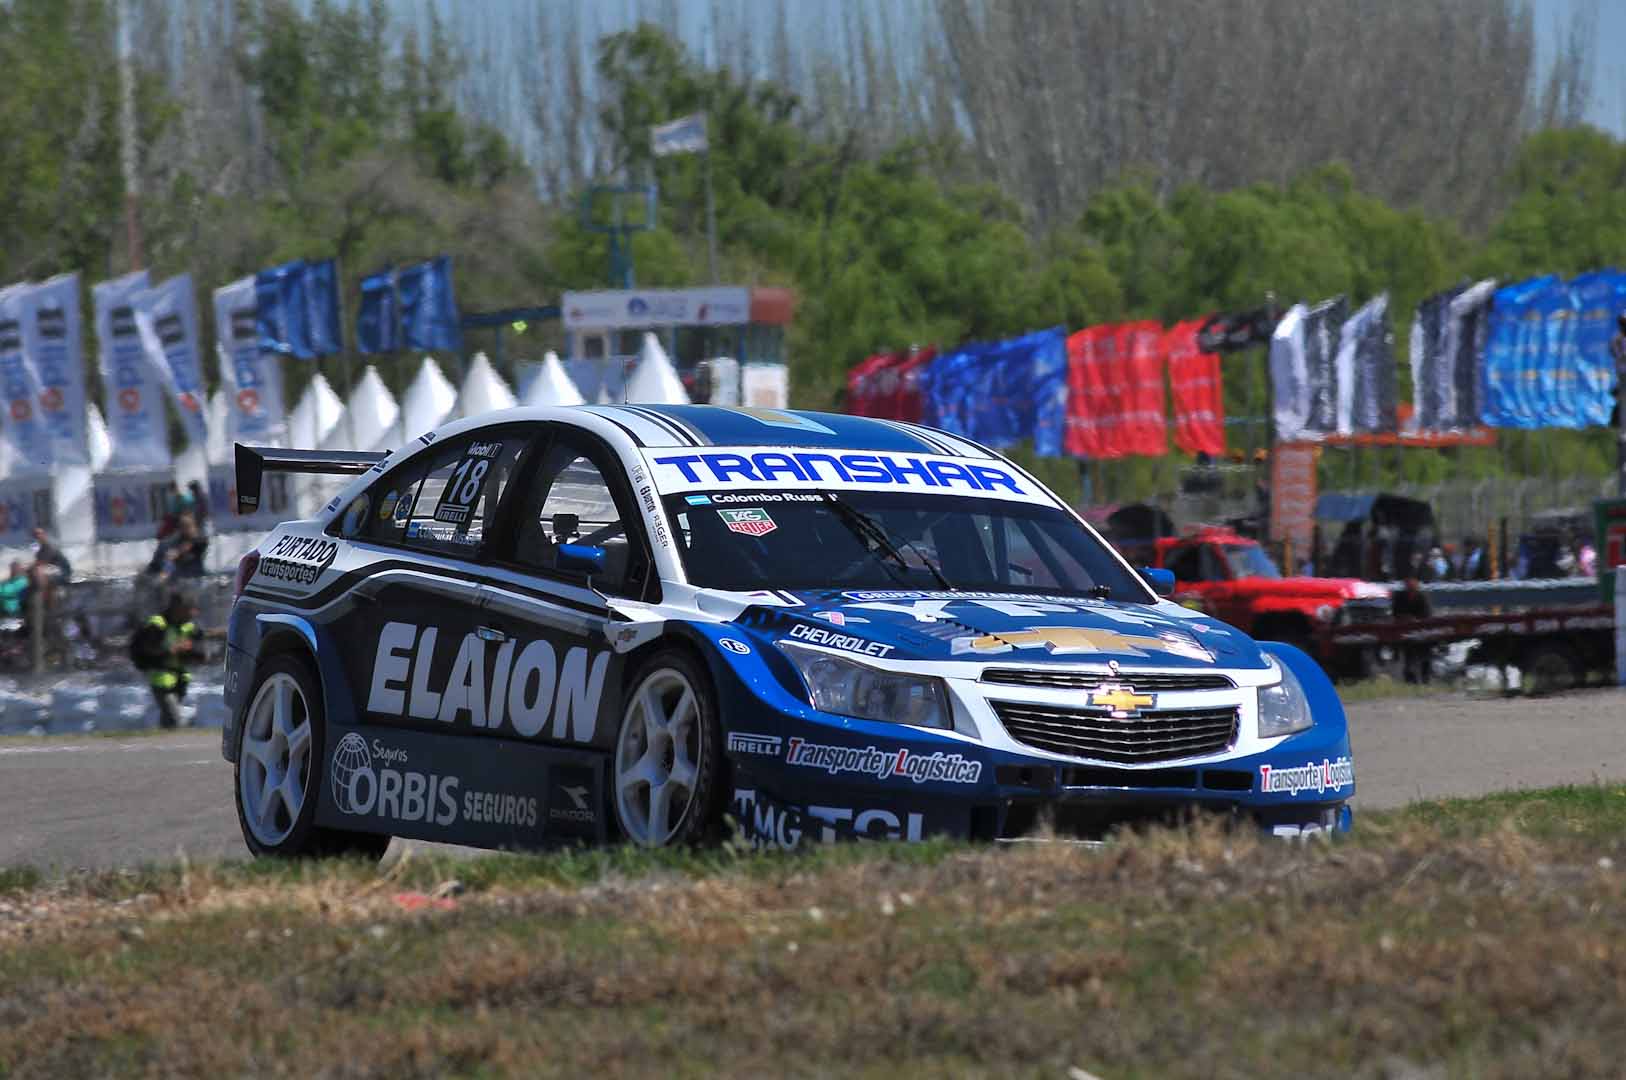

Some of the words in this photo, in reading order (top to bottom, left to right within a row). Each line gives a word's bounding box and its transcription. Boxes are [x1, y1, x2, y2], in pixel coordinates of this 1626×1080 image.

[448, 458, 489, 505] 18
[654, 453, 1027, 495] TRANSHAR
[435, 502, 470, 522] PIRELLI
[712, 493, 783, 503] Colombo
[727, 510, 762, 522] TAG
[730, 521, 773, 534] HEUER
[268, 535, 337, 563] FURTADO
[261, 558, 317, 584] transportes
[721, 639, 747, 653] 18
[790, 623, 895, 658] CHEVROLET
[367, 621, 612, 743] ELAION
[371, 738, 408, 766] Seguros
[728, 732, 782, 756] PIRELLI
[787, 737, 882, 774] Transporte
[895, 748, 982, 784] Logística
[349, 766, 459, 827] ORBIS
[463, 790, 537, 828] SEGUROS
